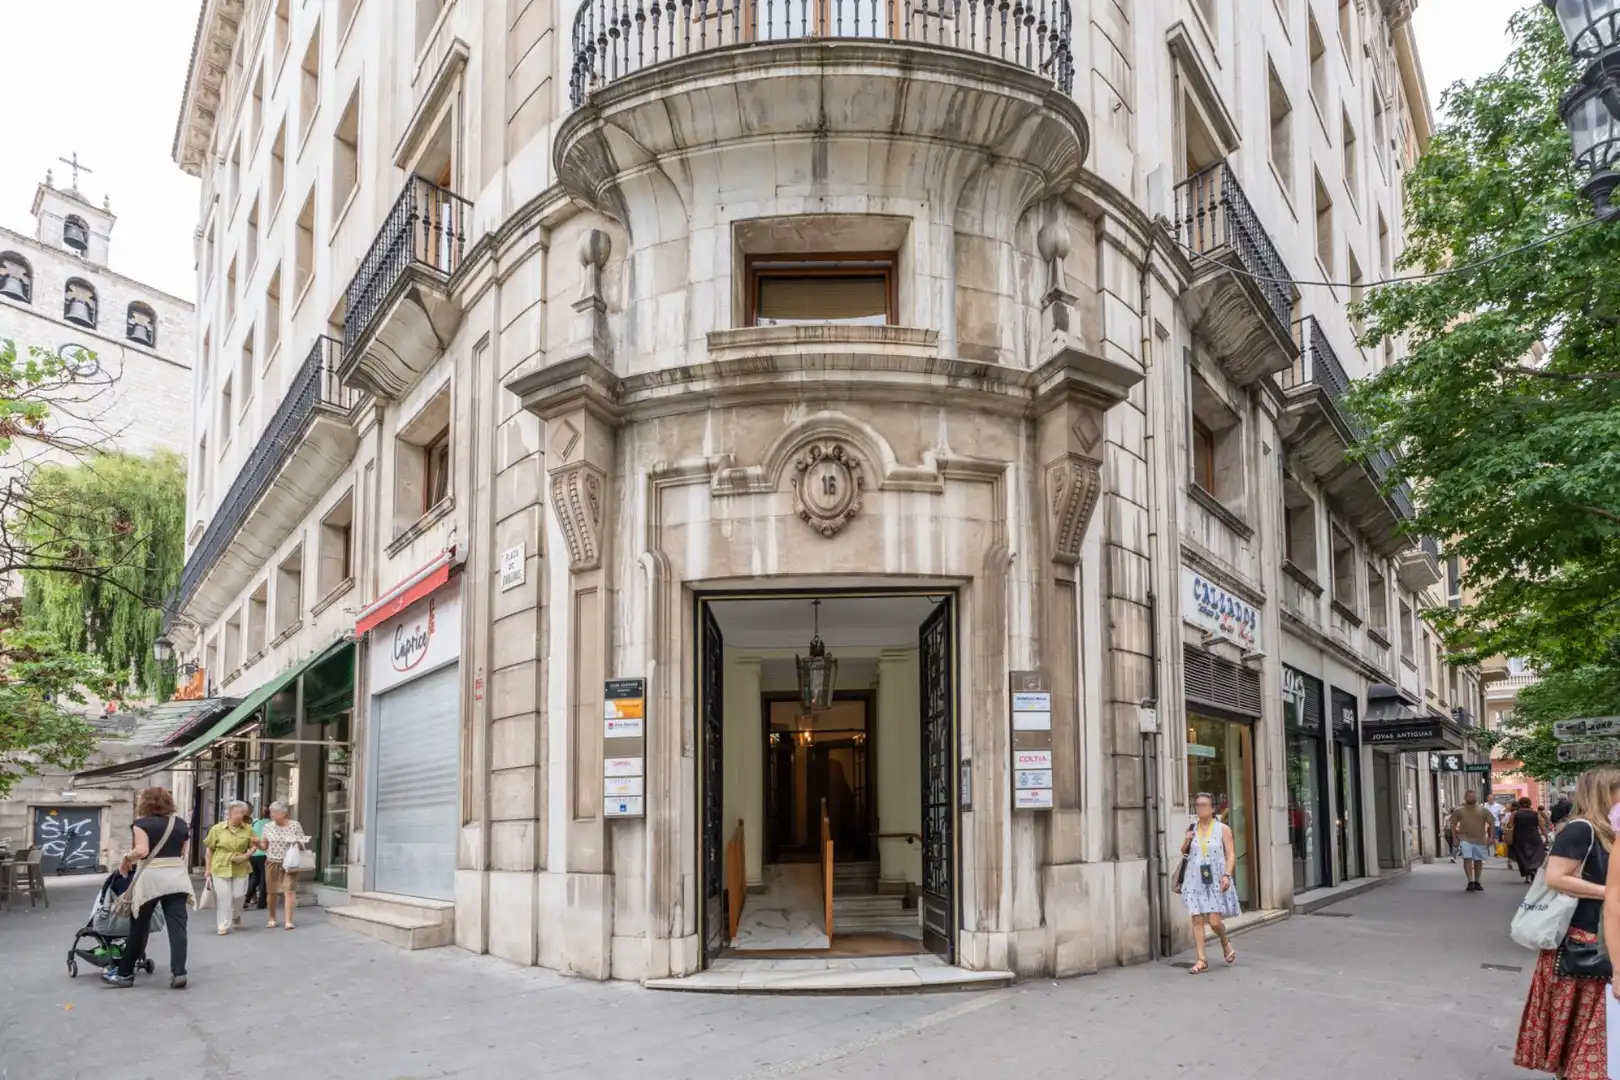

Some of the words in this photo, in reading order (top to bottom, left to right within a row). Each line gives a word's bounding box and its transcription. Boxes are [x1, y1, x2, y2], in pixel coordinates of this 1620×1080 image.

[394, 623, 427, 668] Caprice
[1372, 732, 1394, 740] JOYAS
[1396, 730, 1433, 739] ANTIGUAS
